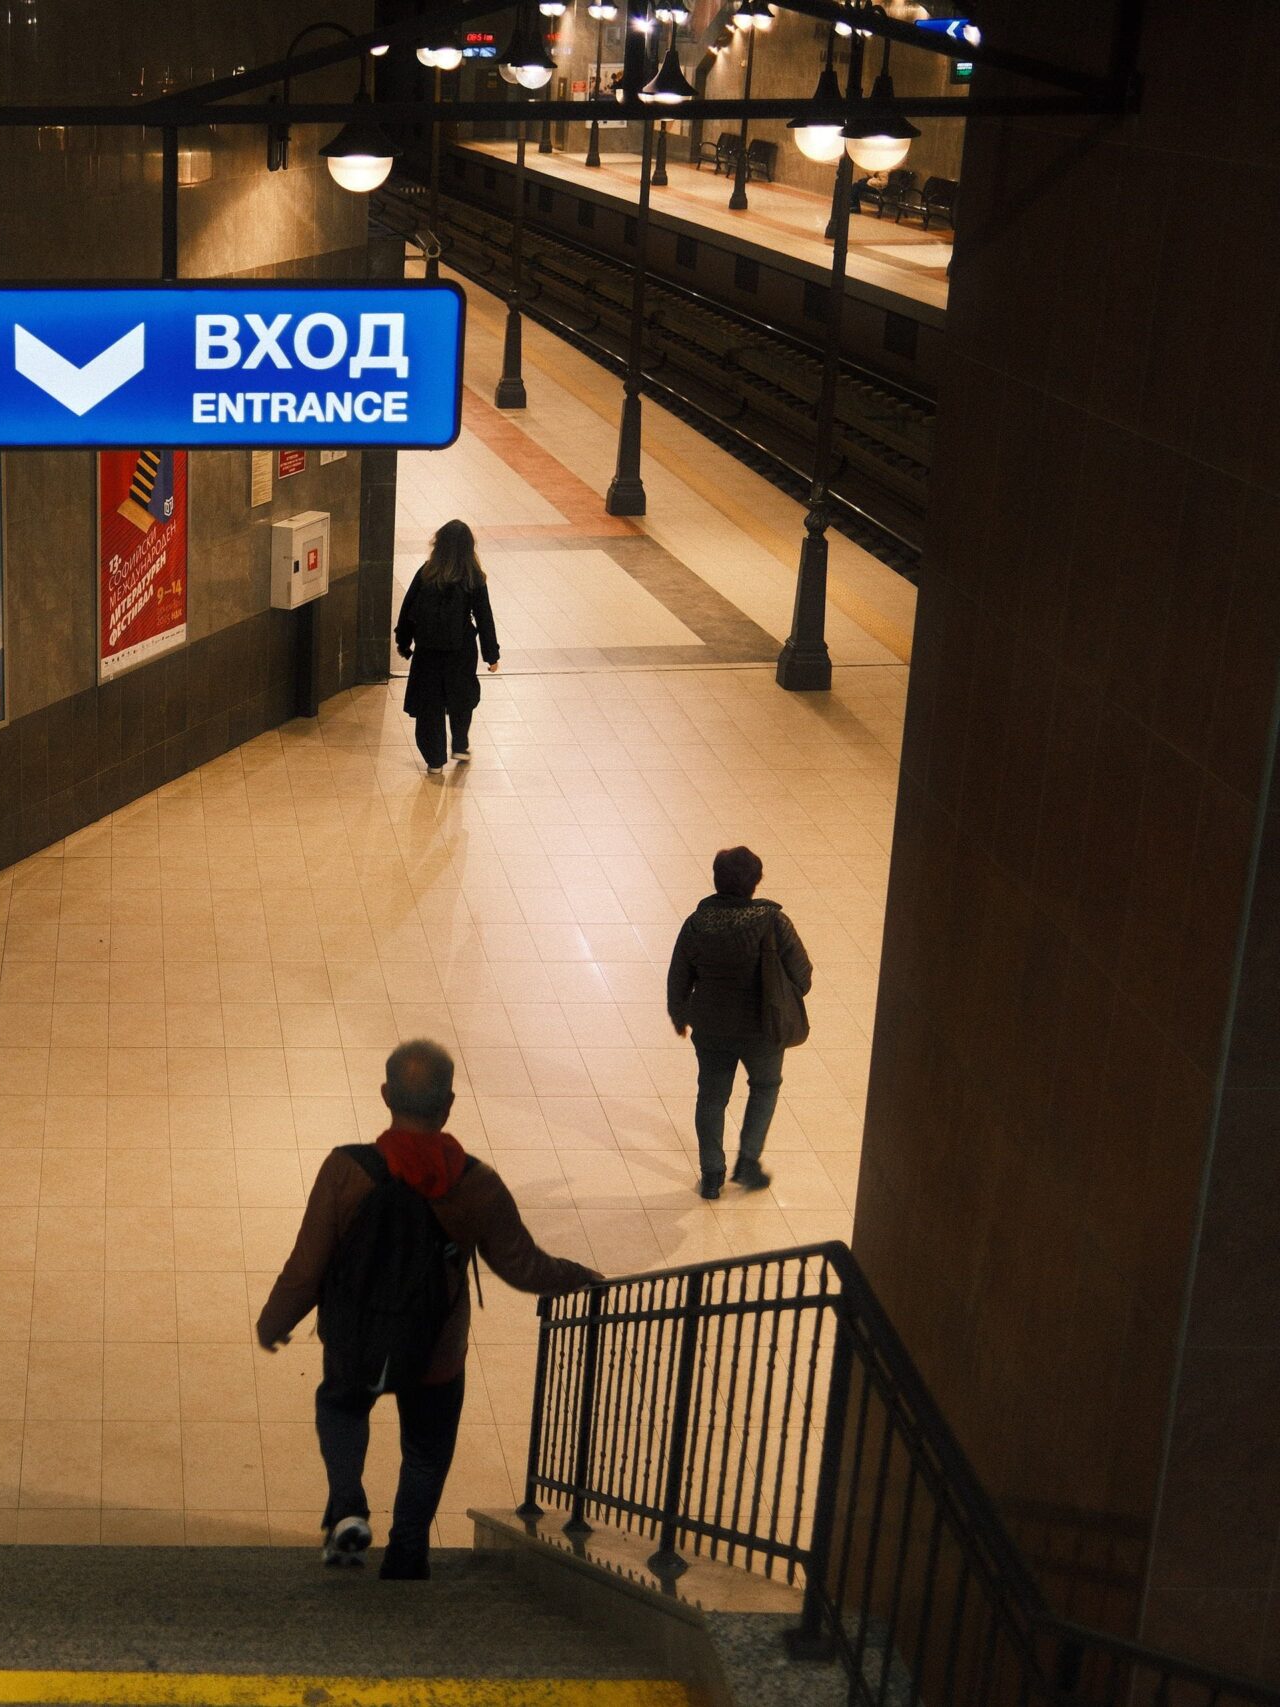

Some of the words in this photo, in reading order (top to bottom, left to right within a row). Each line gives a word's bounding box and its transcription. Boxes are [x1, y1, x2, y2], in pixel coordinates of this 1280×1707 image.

[195, 312, 409, 379] ВХОД
[192, 390, 408, 423] ENTRANCE
[109, 519, 177, 612] МЕЖДУНАРОДЕН
[109, 550, 167, 630] ЛИТЕРАТУРЕН
[109, 584, 154, 647] ФЕСТИВАЛ
